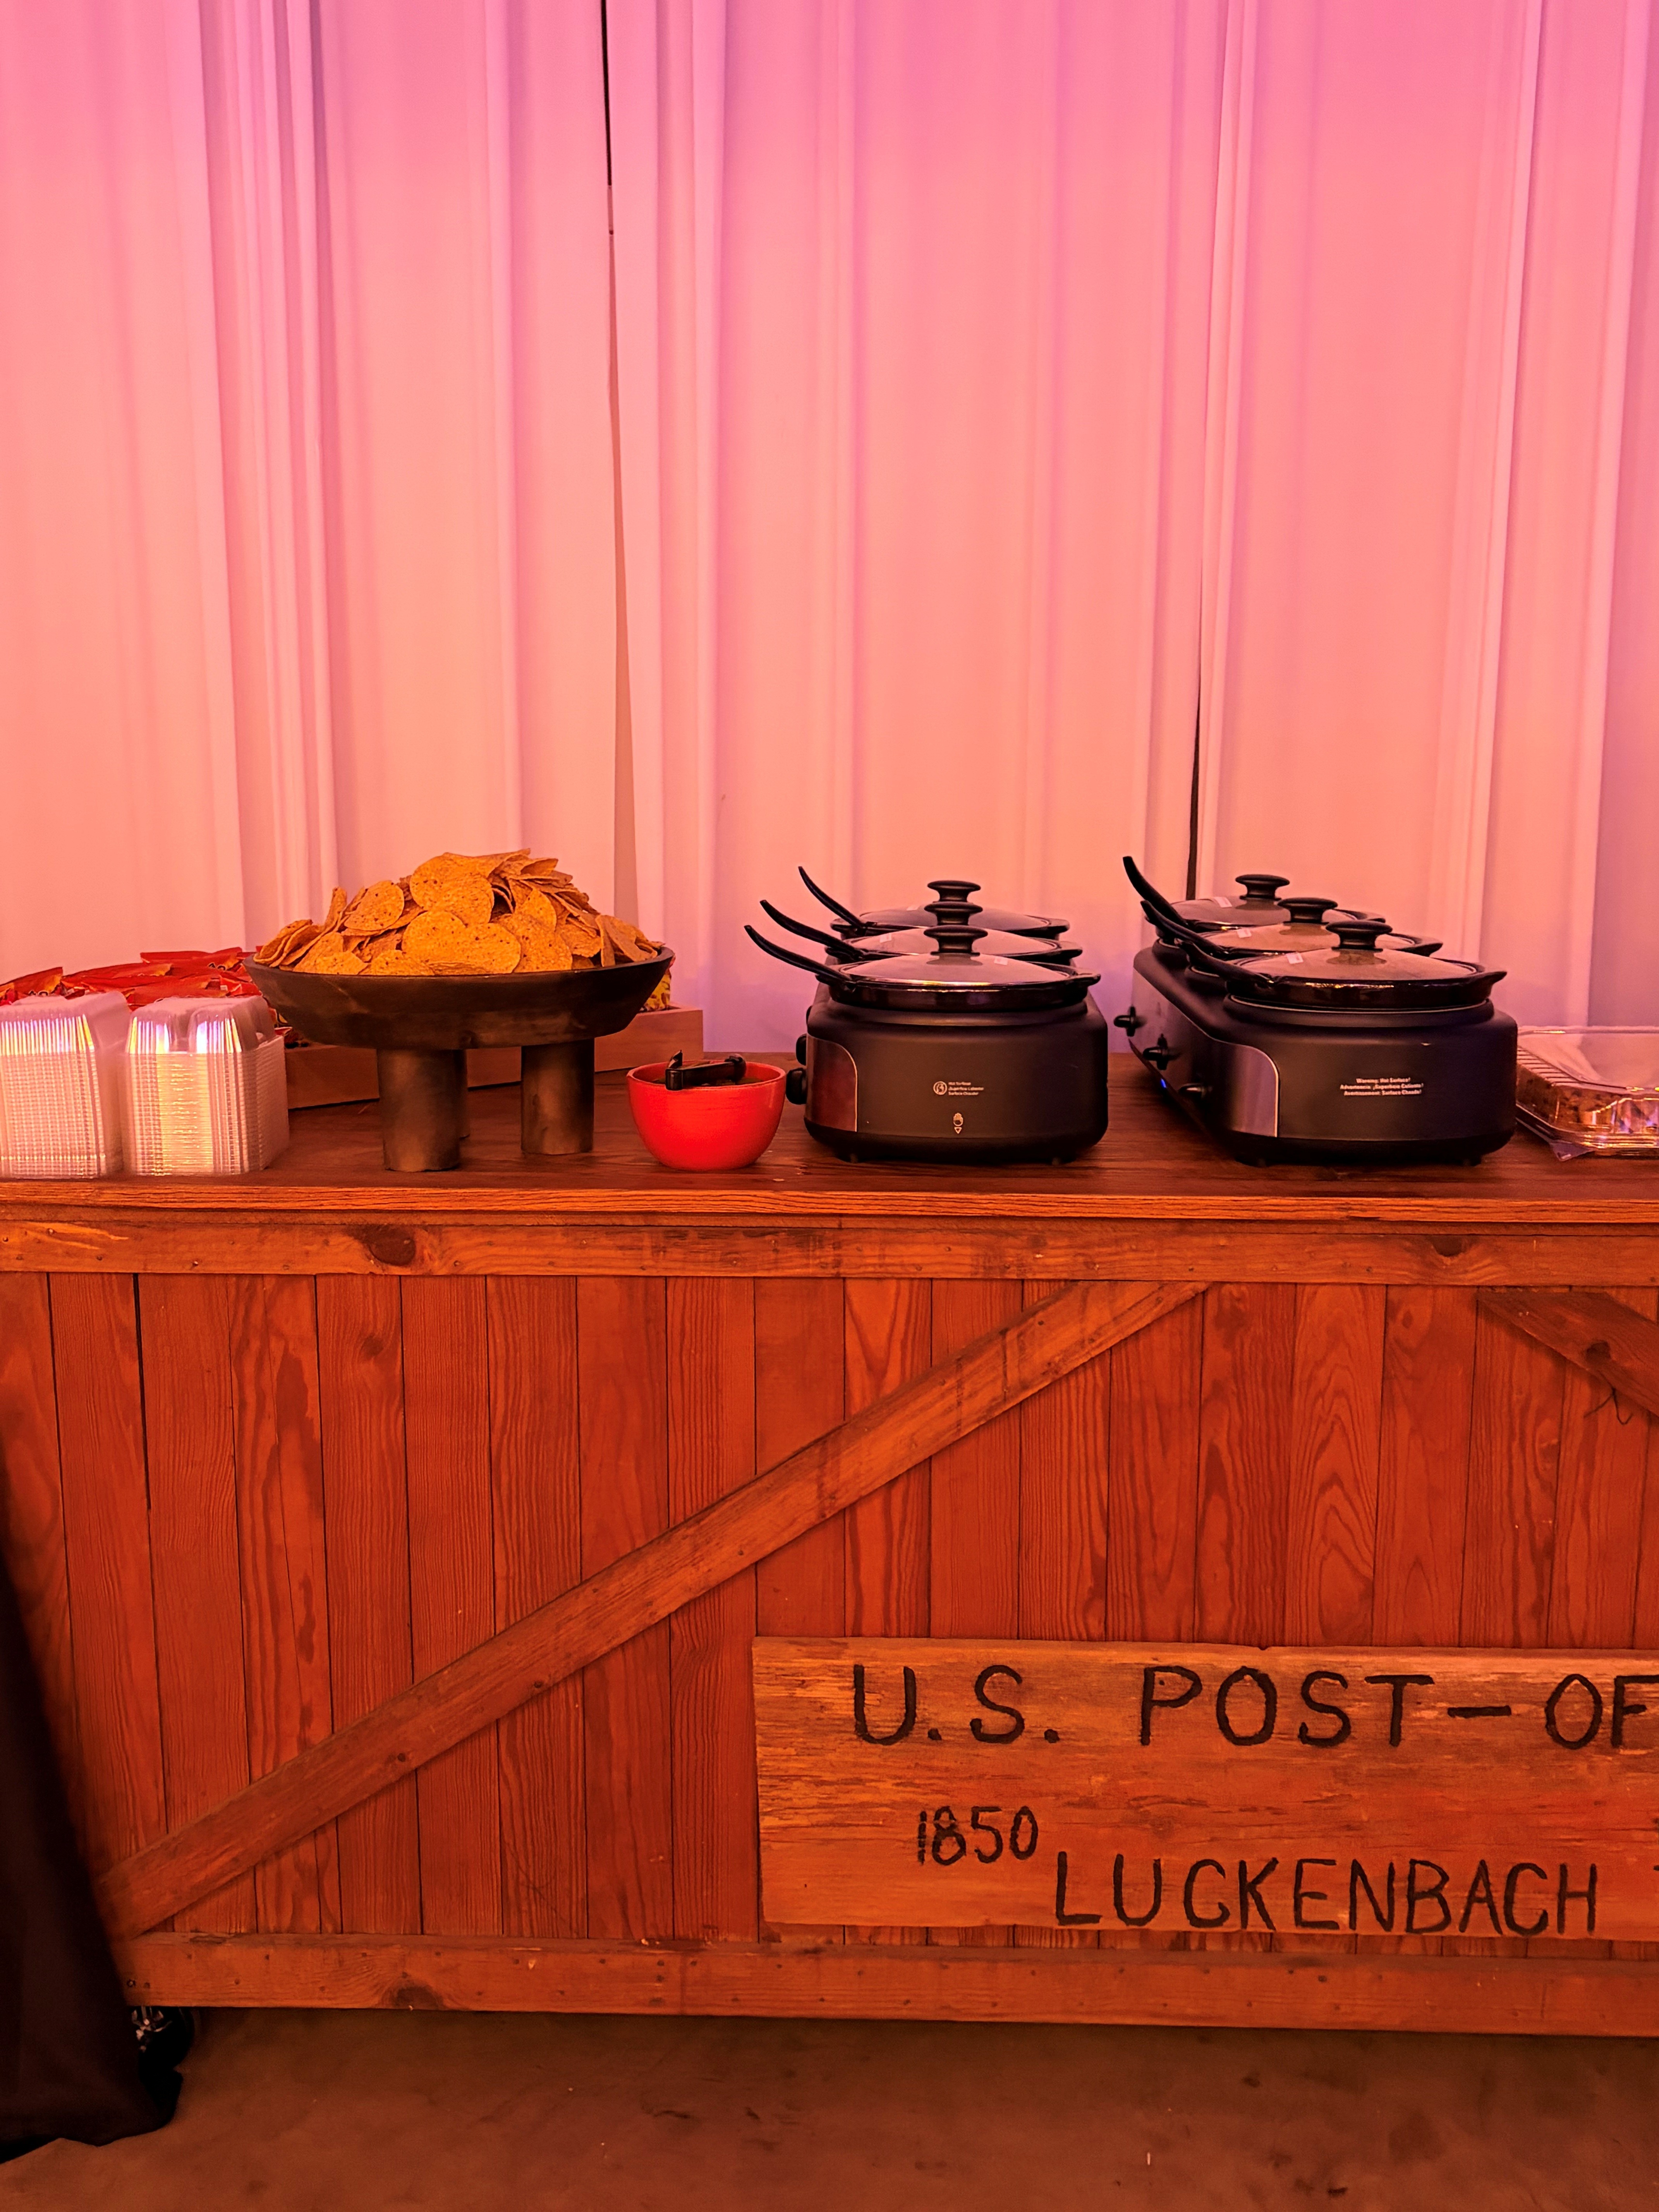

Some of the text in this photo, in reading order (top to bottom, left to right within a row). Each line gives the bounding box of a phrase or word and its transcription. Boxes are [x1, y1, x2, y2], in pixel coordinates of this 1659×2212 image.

[853, 1664, 1061, 1746] U.S.
[916, 1805, 1039, 1866] 1850
[1055, 1851, 1597, 1936] LUCKENBACH
